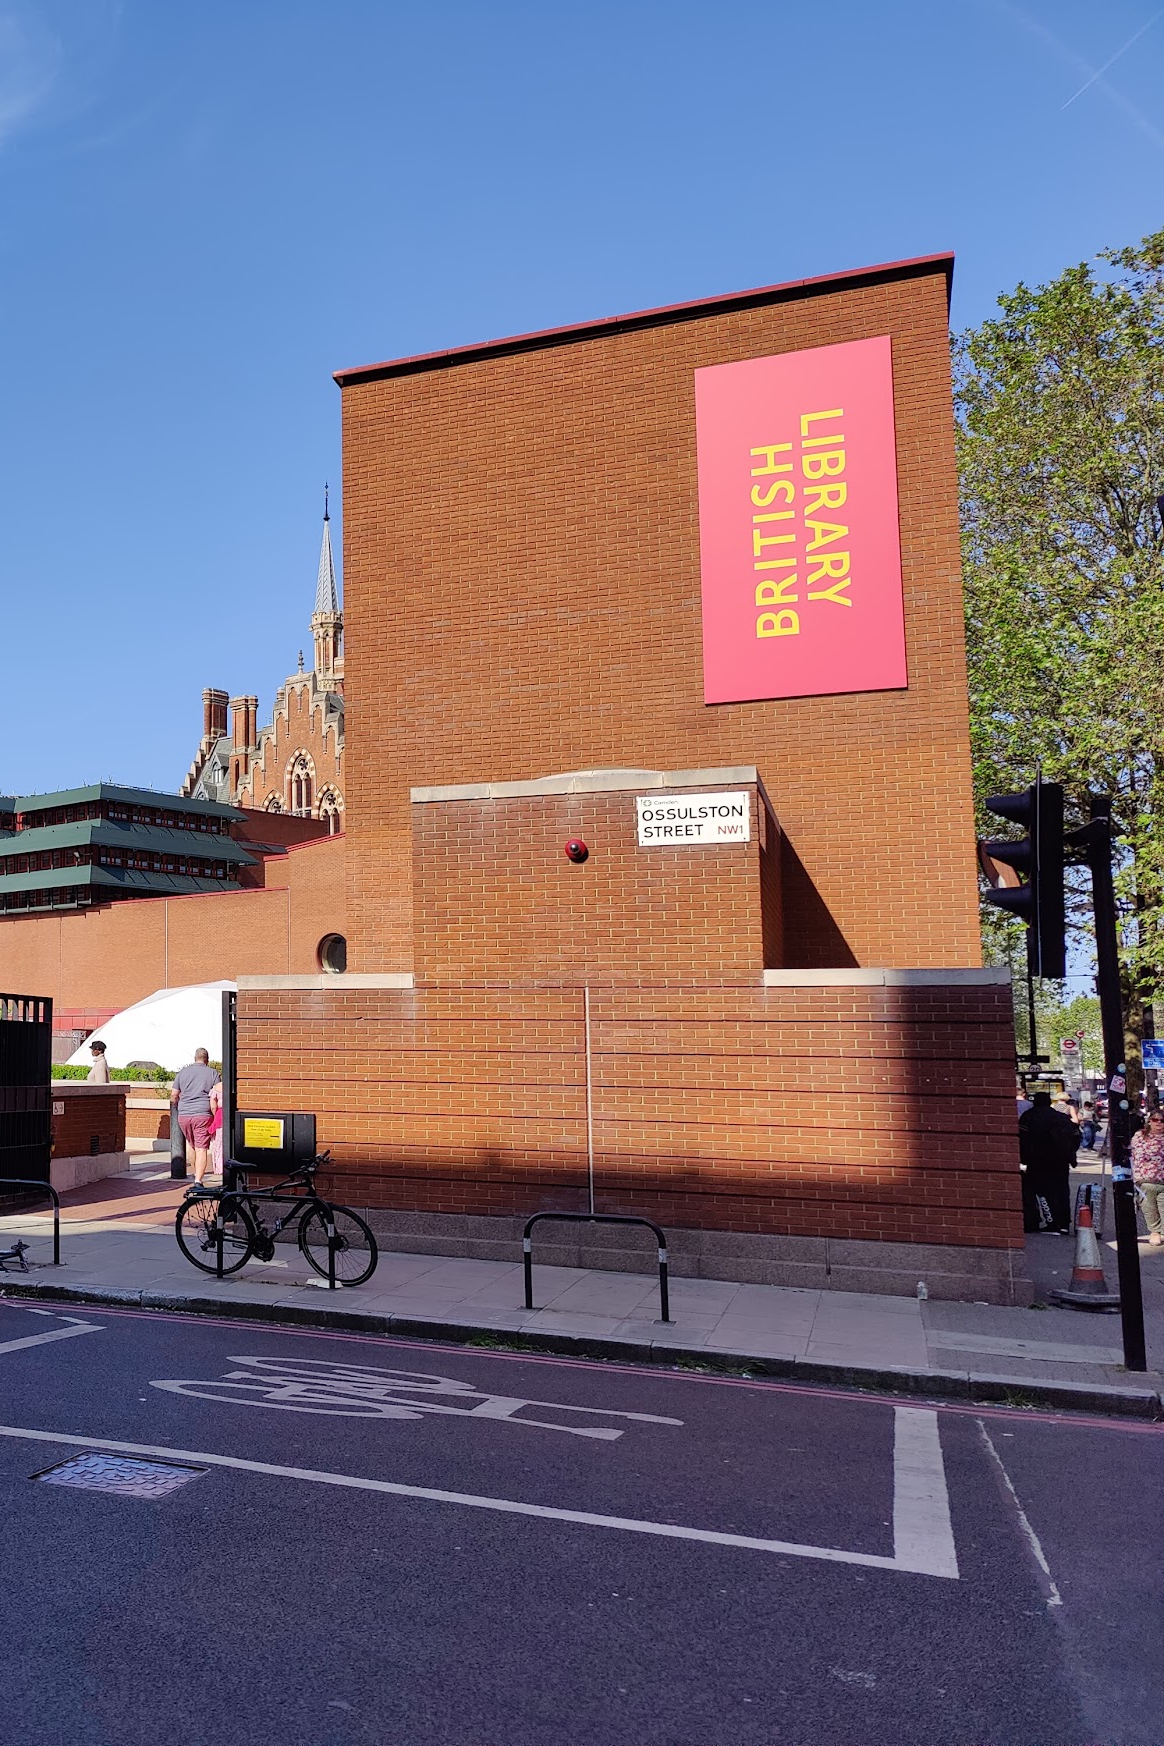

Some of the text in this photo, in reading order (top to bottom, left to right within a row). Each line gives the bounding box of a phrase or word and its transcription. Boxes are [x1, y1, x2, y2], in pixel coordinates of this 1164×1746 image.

[750, 442, 800, 638] BRITISH
[800, 408, 852, 607] LIBRARY
[642, 805, 743, 821] OSSULSTON
[644, 824, 743, 838] STREET NW1
